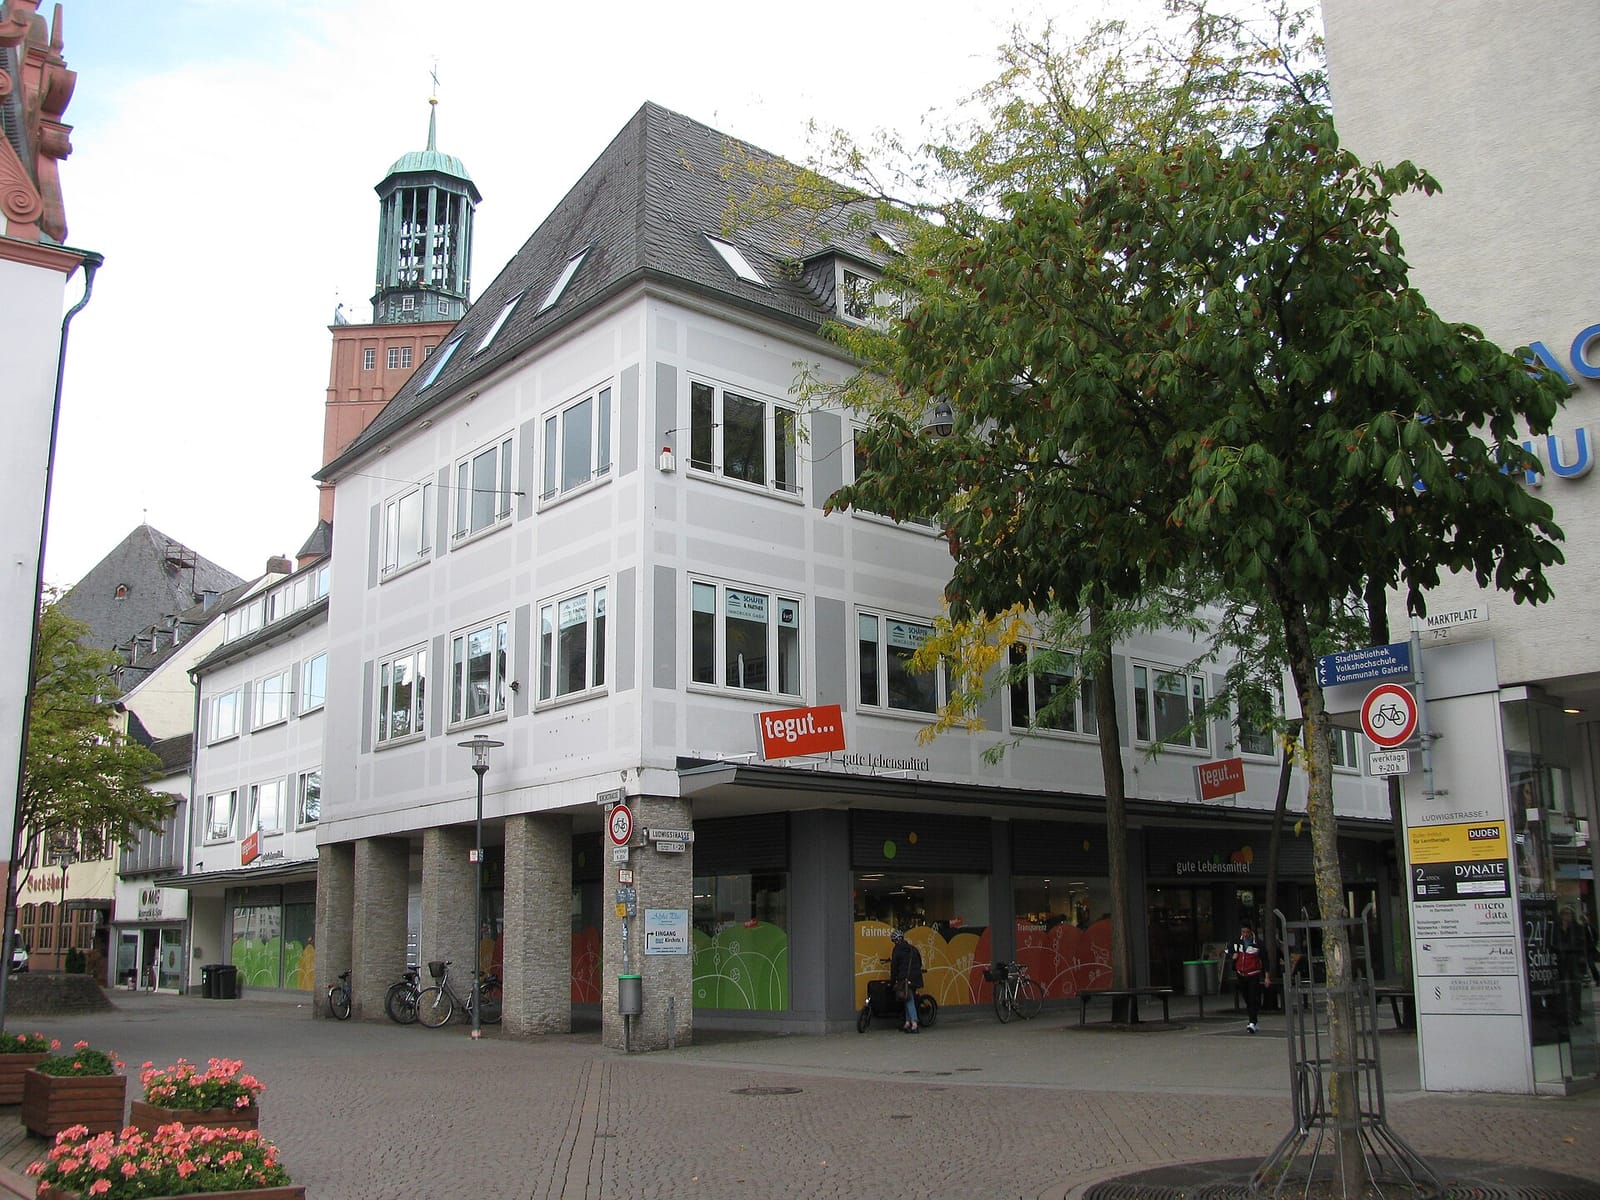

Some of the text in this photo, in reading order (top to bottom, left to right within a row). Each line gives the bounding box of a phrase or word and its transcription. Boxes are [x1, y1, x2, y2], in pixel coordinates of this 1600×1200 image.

[1427, 609, 1478, 626] MARKTPLATZ
[1433, 629, 1447, 639] 7-2
[1335, 648, 1389, 664] Stadtbibliothek
[1335, 657, 1397, 673] Volkshochschule
[1336, 664, 1409, 682] Kommunale Galerie
[765, 712, 835, 743] tegut...
[842, 753, 929, 771] gute Lebensmittel
[1372, 754, 1405, 763] werktags
[1201, 764, 1239, 787] tegut...
[1421, 810, 1483, 822] LUDWIGSTRASSE
[1469, 828, 1499, 838] DUDEN
[1176, 860, 1250, 875] gute Lebensmittel
[1474, 902, 1505, 910] micro
[1485, 910, 1508, 919] data
[1526, 917, 1554, 952] 24/7
